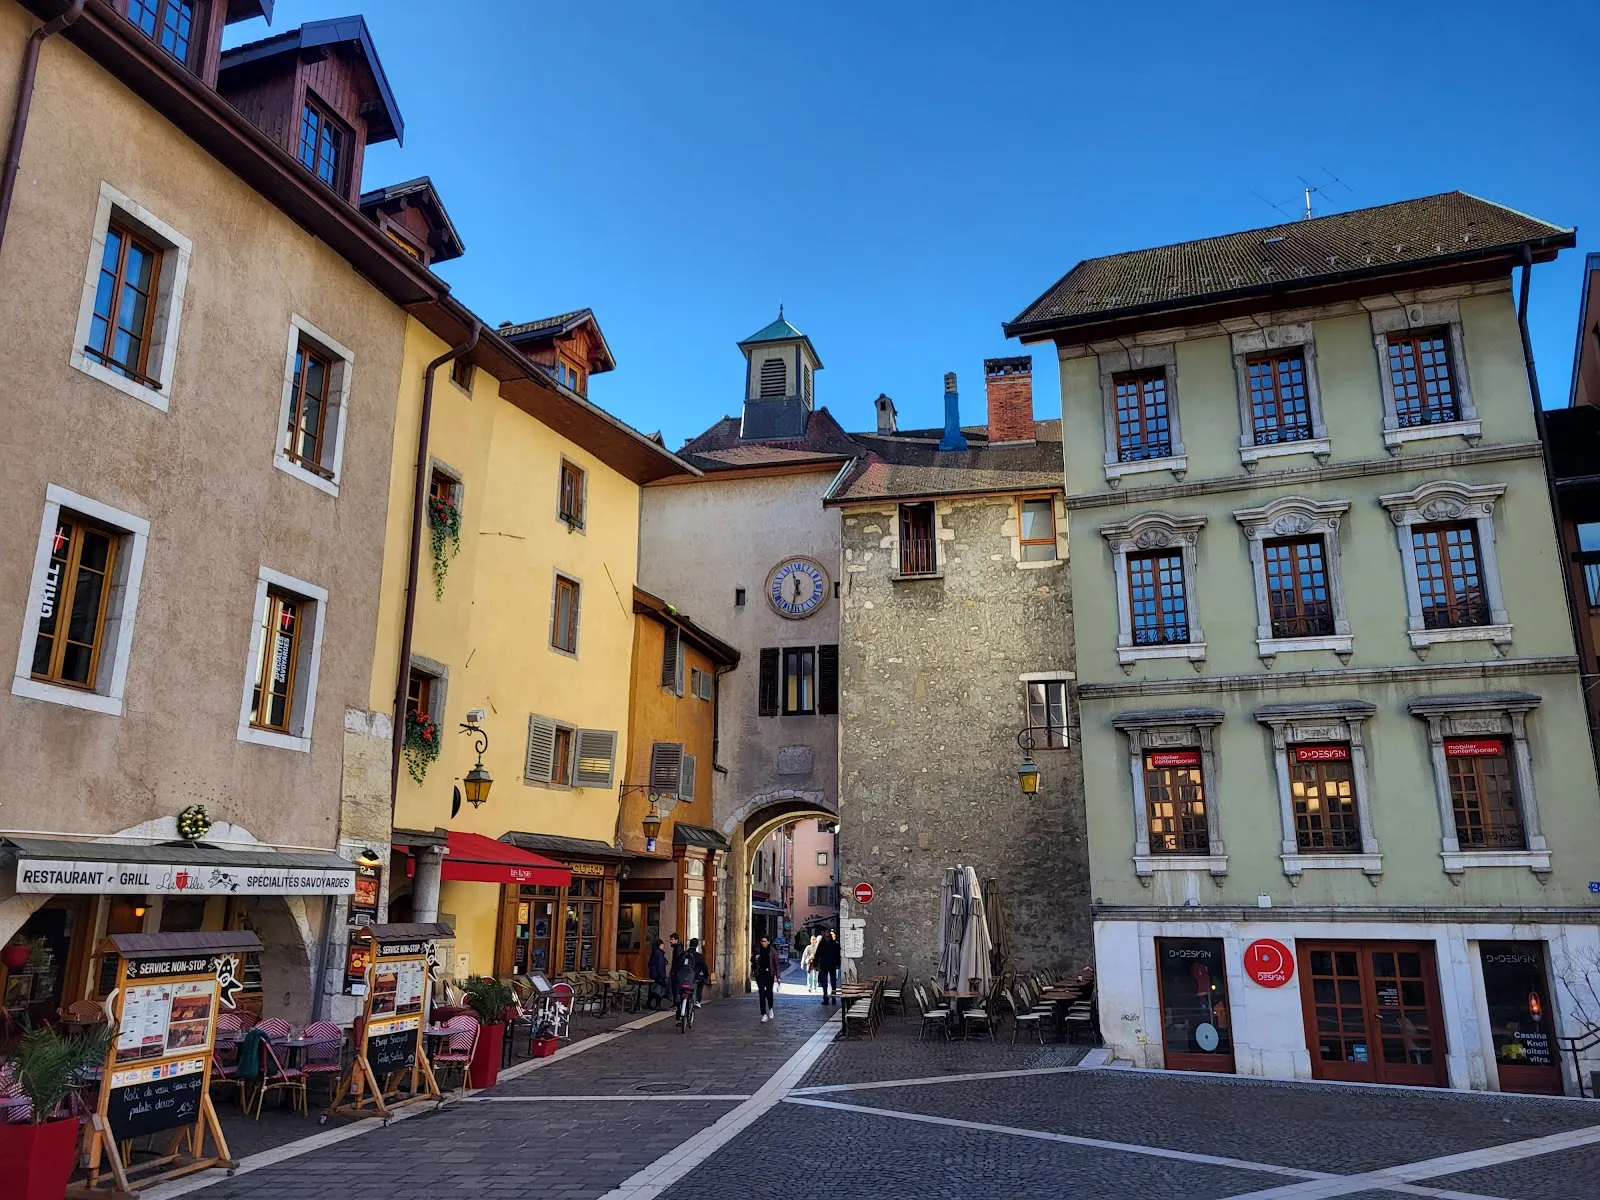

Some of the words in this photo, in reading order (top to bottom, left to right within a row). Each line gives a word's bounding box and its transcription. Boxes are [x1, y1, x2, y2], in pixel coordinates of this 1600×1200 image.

[280, 637, 290, 683] SAVOYARDES
[1449, 747, 1498, 755] contemporain
[23, 870, 104, 885] RESTAURANT
[120, 872, 150, 886] GRILL
[156, 872, 175, 890] Les
[247, 873, 299, 888] SPÉCIALITÉS
[300, 875, 350, 889] SAVOYARDES
[382, 945, 400, 955] SERVICE
[400, 944, 421, 953] NON-STOP
[140, 962, 170, 975] SERVICE
[171, 960, 207, 973] NON-STOP
[1257, 973, 1285, 982] DESIGN
[1514, 1031, 1547, 1039] Cassina
[1519, 1047, 1549, 1055] Molteni
[144, 1085, 154, 1097] de
